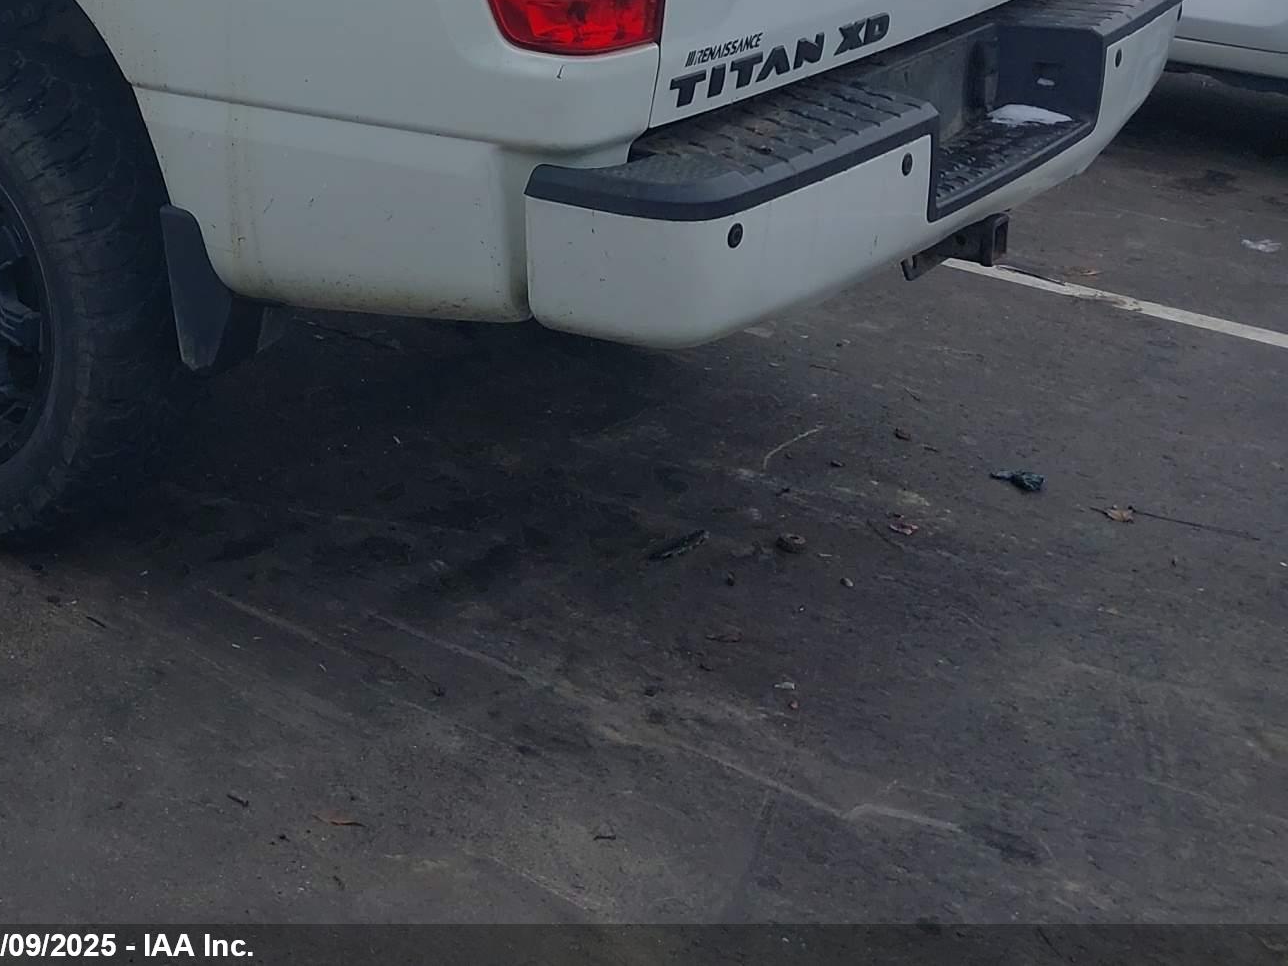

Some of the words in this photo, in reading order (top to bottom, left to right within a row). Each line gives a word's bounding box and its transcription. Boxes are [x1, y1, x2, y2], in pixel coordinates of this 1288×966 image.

[670, 32, 825, 108] TITAN
[834, 14, 891, 56] XD
[694, 32, 763, 66] RENAISSANCE
